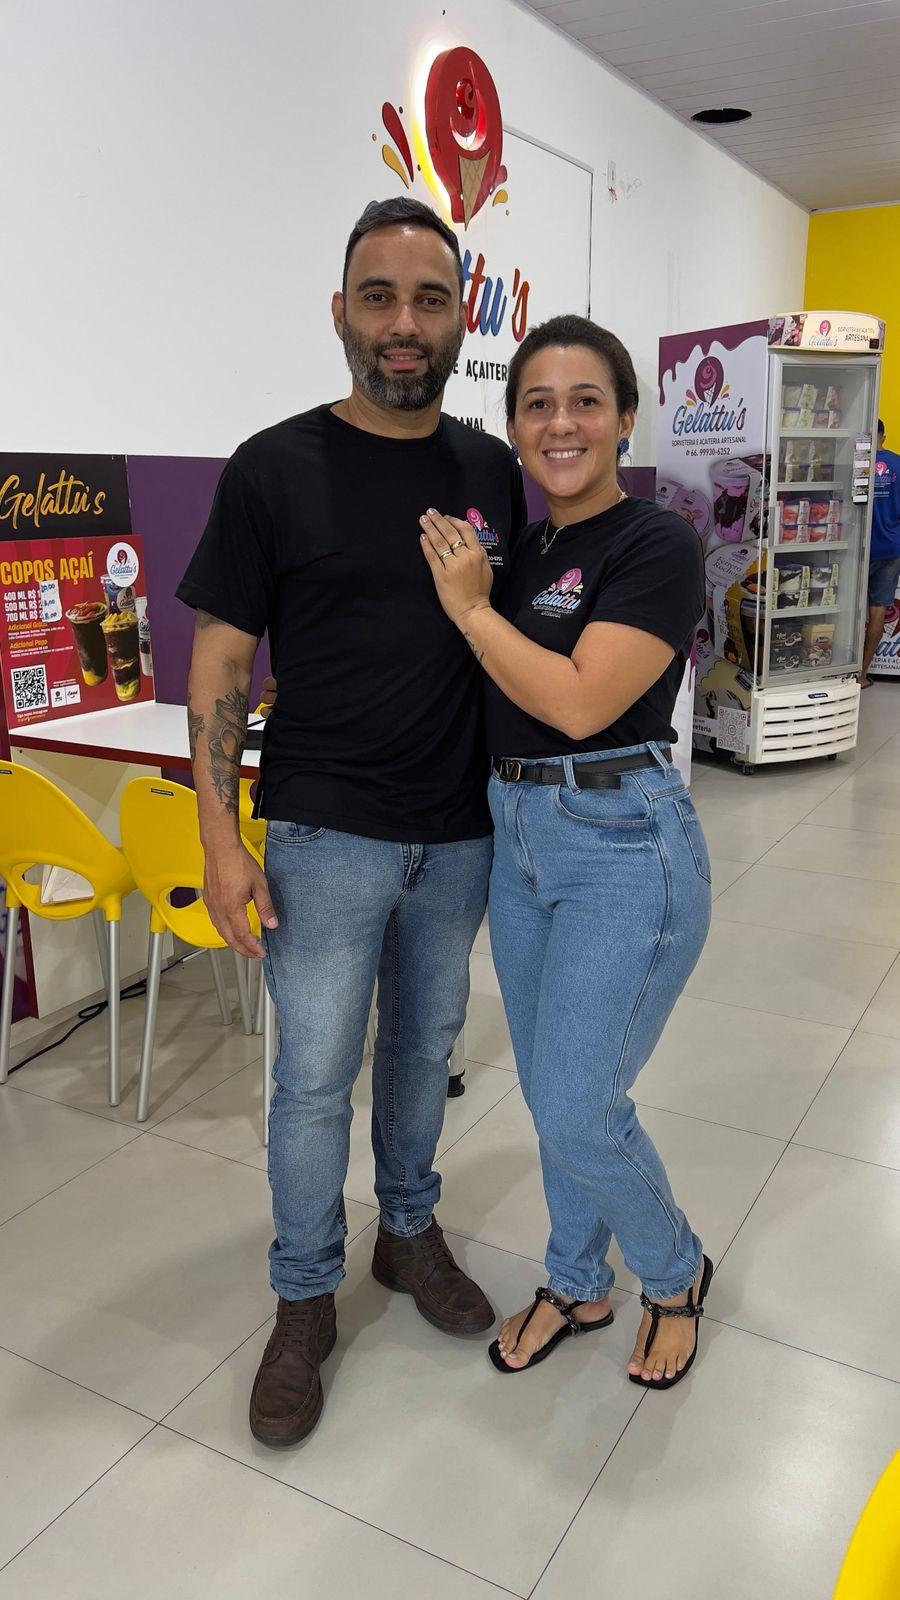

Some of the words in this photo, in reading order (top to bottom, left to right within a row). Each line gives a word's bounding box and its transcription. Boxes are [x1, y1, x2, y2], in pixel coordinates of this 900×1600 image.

[466, 359, 508, 382] AÇAITER
[672, 398, 747, 436] Gelattu's
[721, 436, 747, 444] ARTESANAL
[0, 469, 106, 530] Gelattu's
[0, 558, 55, 585] COPOS
[60, 550, 94, 585] AÇAÍ
[4, 591, 16, 601] 400
[17, 590, 27, 600] ML
[28, 589, 37, 600] R$
[5, 602, 17, 612] 500
[19, 601, 28, 610] ML
[29, 600, 38, 610] R$
[6, 612, 18, 622] 700
[20, 611, 28, 621] ML
[30, 610, 38, 620] R$
